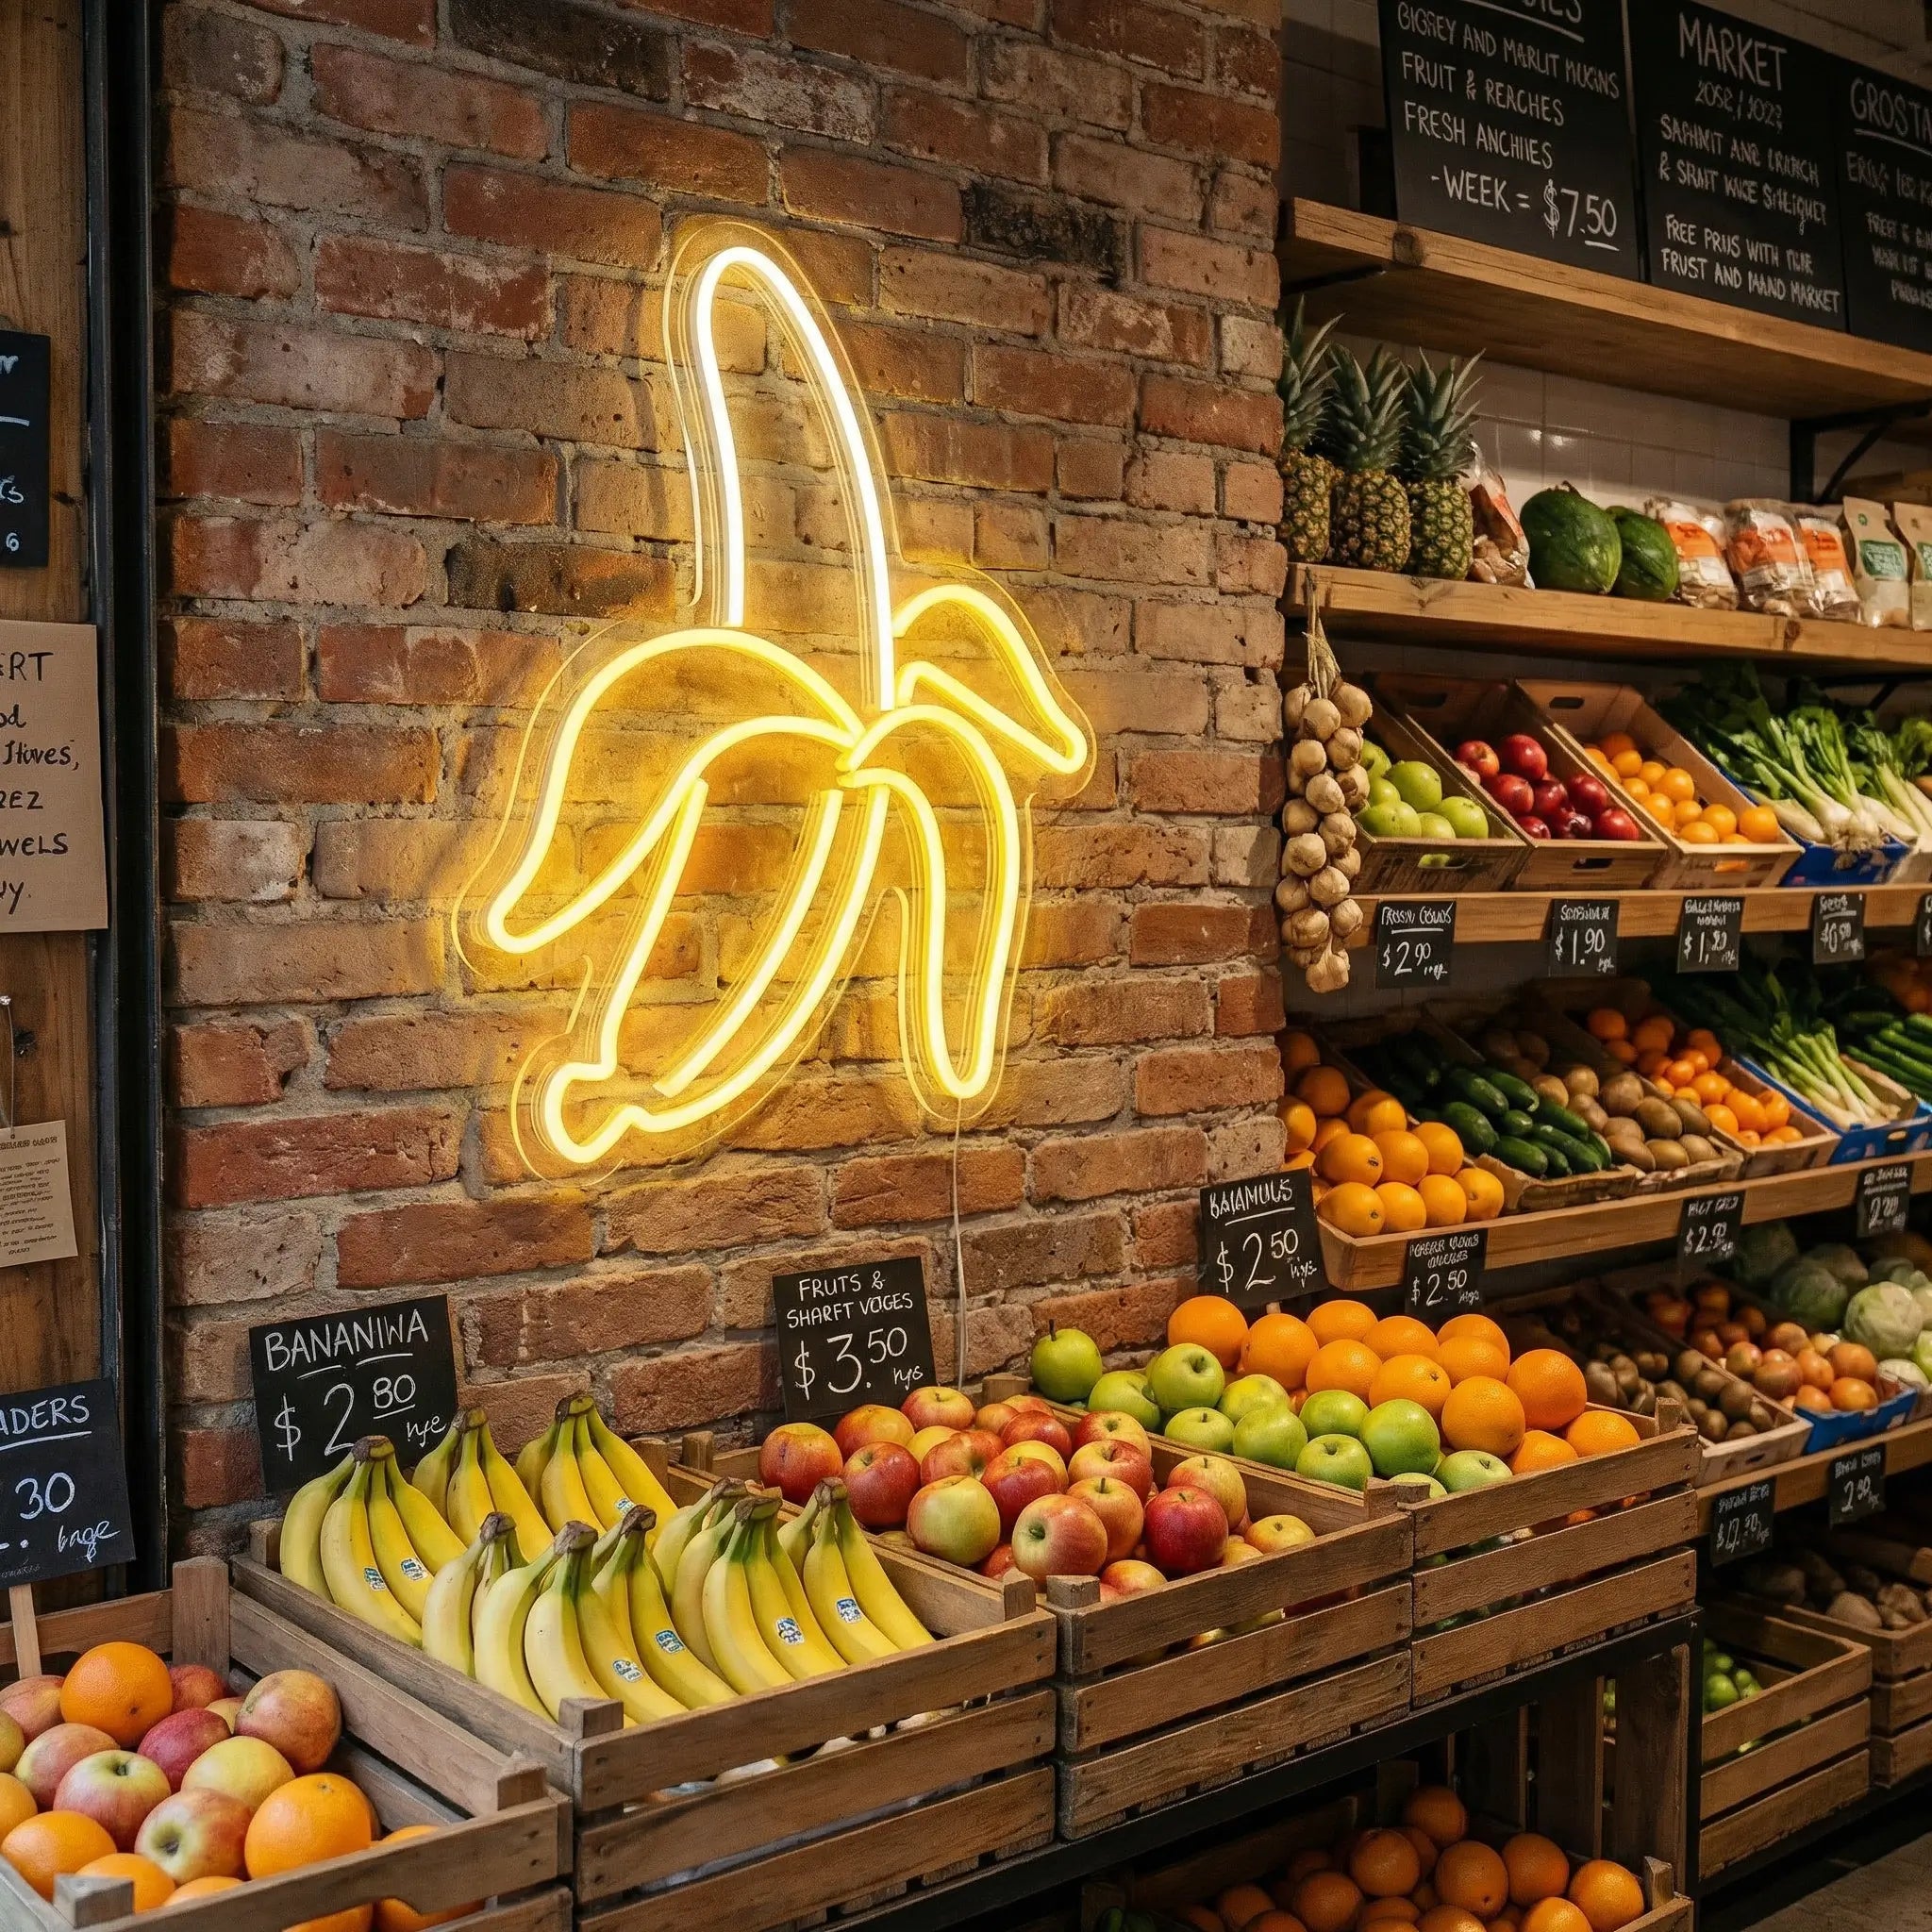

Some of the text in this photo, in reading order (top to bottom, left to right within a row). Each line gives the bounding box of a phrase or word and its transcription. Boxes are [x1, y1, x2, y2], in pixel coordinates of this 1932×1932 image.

[1463, 24, 1497, 57] AND
[1678, 11, 1788, 92] MARKET
[1402, 51, 1457, 92] FRUIT
[1405, 100, 1465, 146] FRESH
[1666, 213, 1697, 245] FREE
[1661, 248, 1708, 280] FRUST
[1714, 262, 1742, 289] AND
[1791, 280, 1840, 314] MARKET
[799, 1274, 862, 1302] FRUTS
